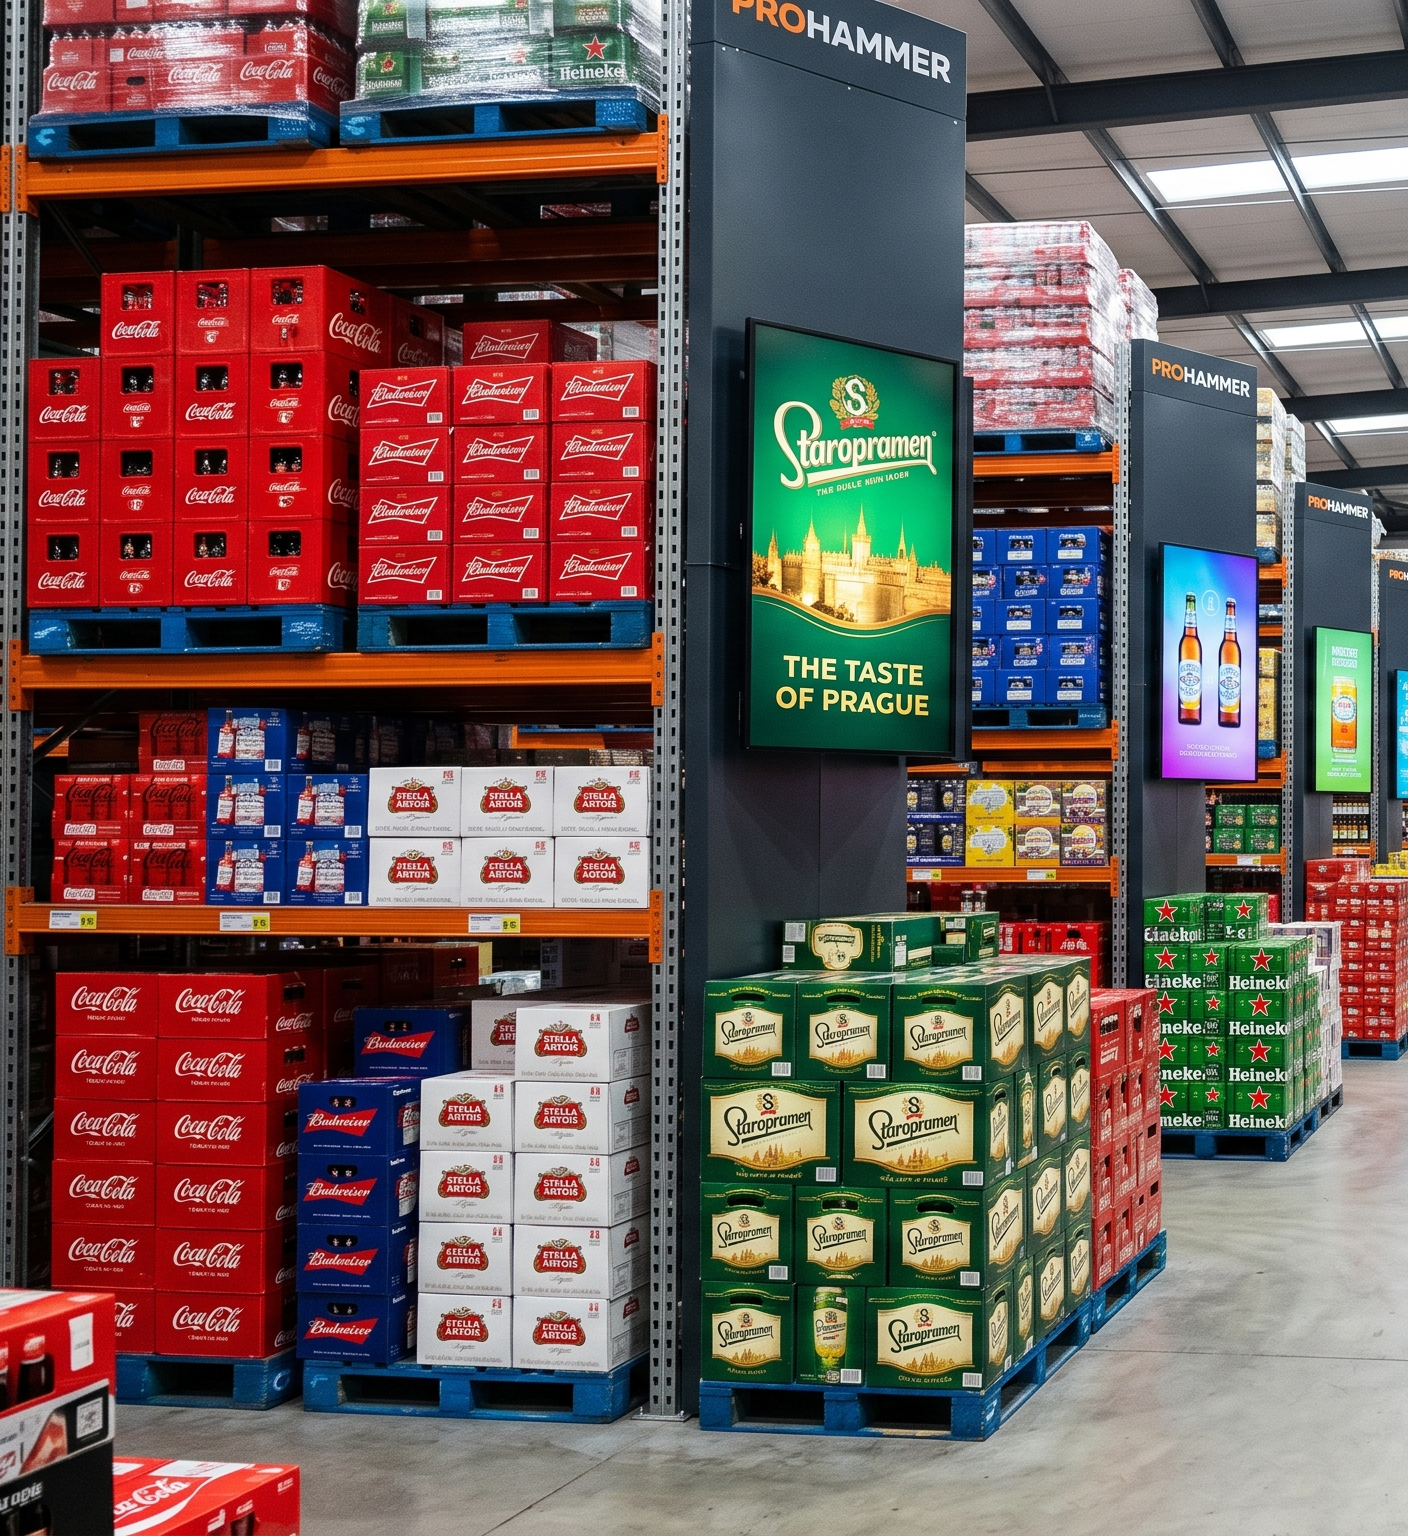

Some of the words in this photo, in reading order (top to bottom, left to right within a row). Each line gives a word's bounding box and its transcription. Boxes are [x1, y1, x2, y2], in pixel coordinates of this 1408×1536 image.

[1152, 358, 1250, 397] PROHAMMER
[774, 401, 937, 490] Staropramen
[1308, 495, 1368, 519] PROHAMMER
[783, 655, 837, 680] THE
[845, 660, 923, 686] TASTE
[776, 686, 814, 709] OF
[823, 689, 929, 716] PRAGUE
[724, 1106, 813, 1146] Staropramen
[869, 1110, 959, 1150] Staropramen
